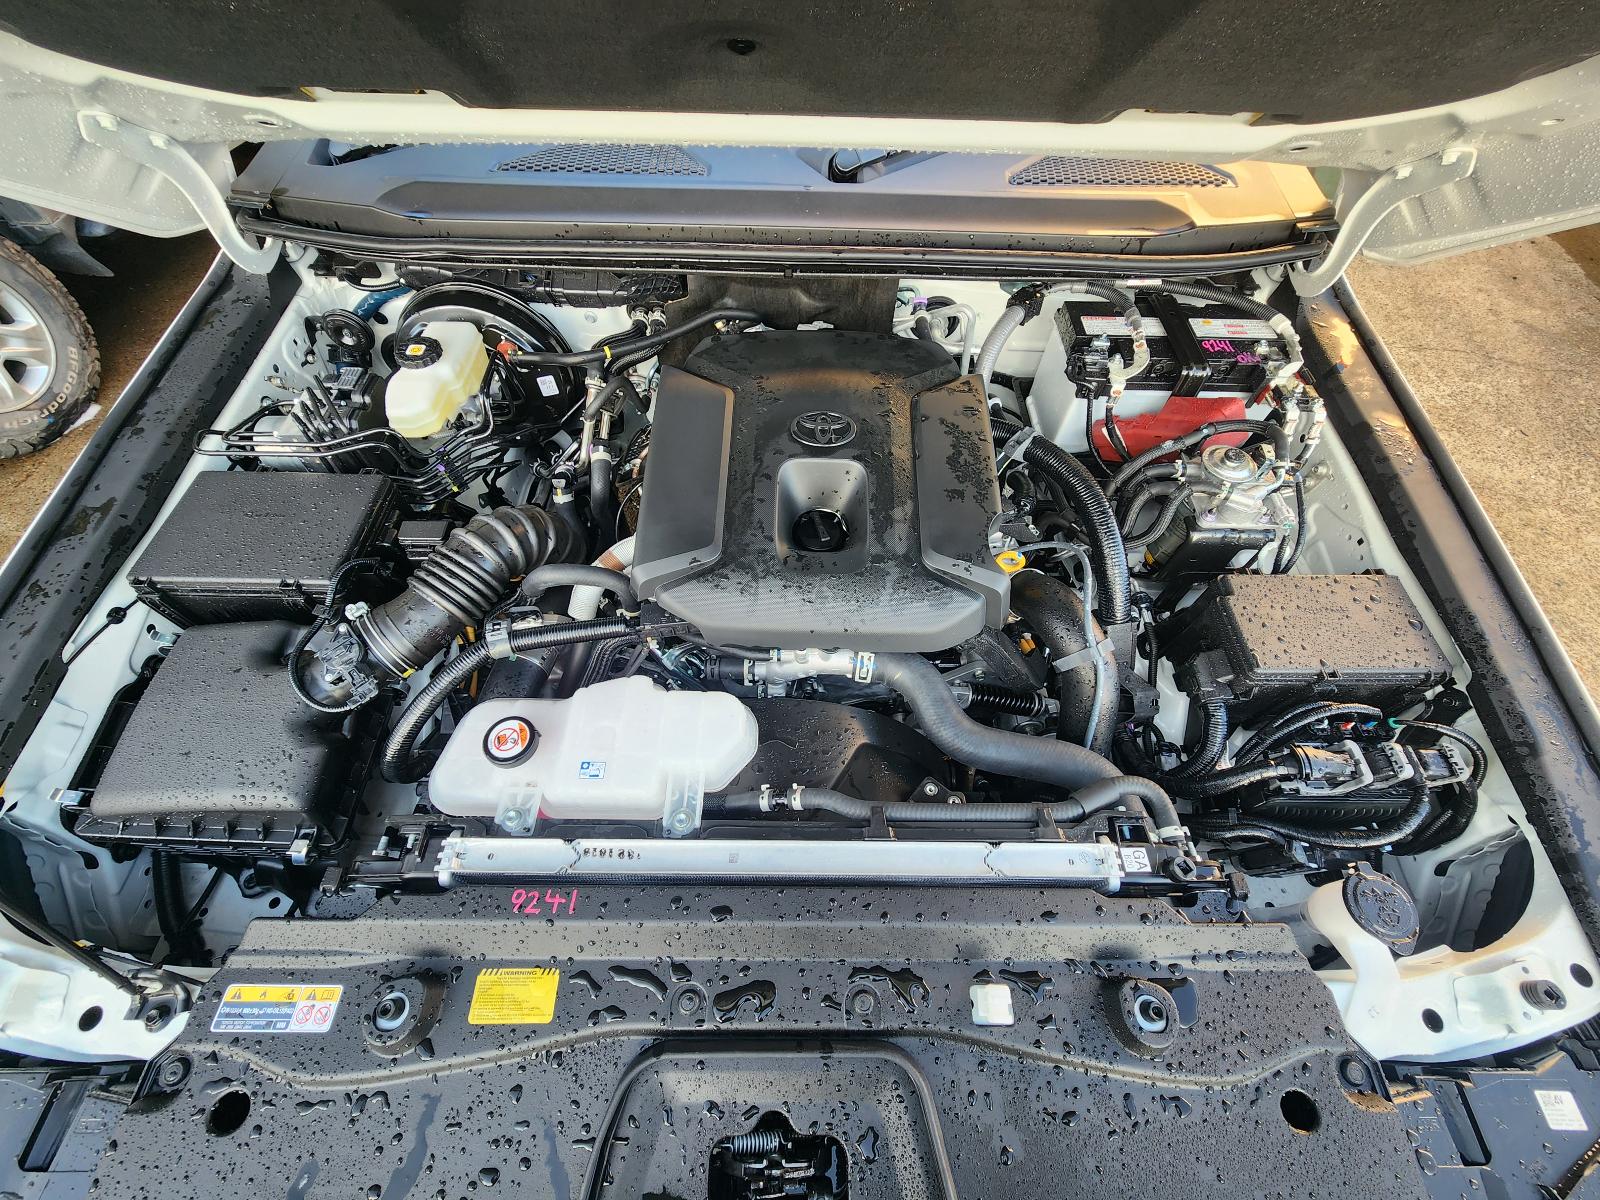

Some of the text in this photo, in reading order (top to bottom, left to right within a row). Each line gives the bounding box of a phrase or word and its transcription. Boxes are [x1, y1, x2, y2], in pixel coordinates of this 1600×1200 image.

[1201, 339, 1235, 353] 9241
[1133, 850, 1148, 870] GA
[511, 888, 578, 914] 9241
